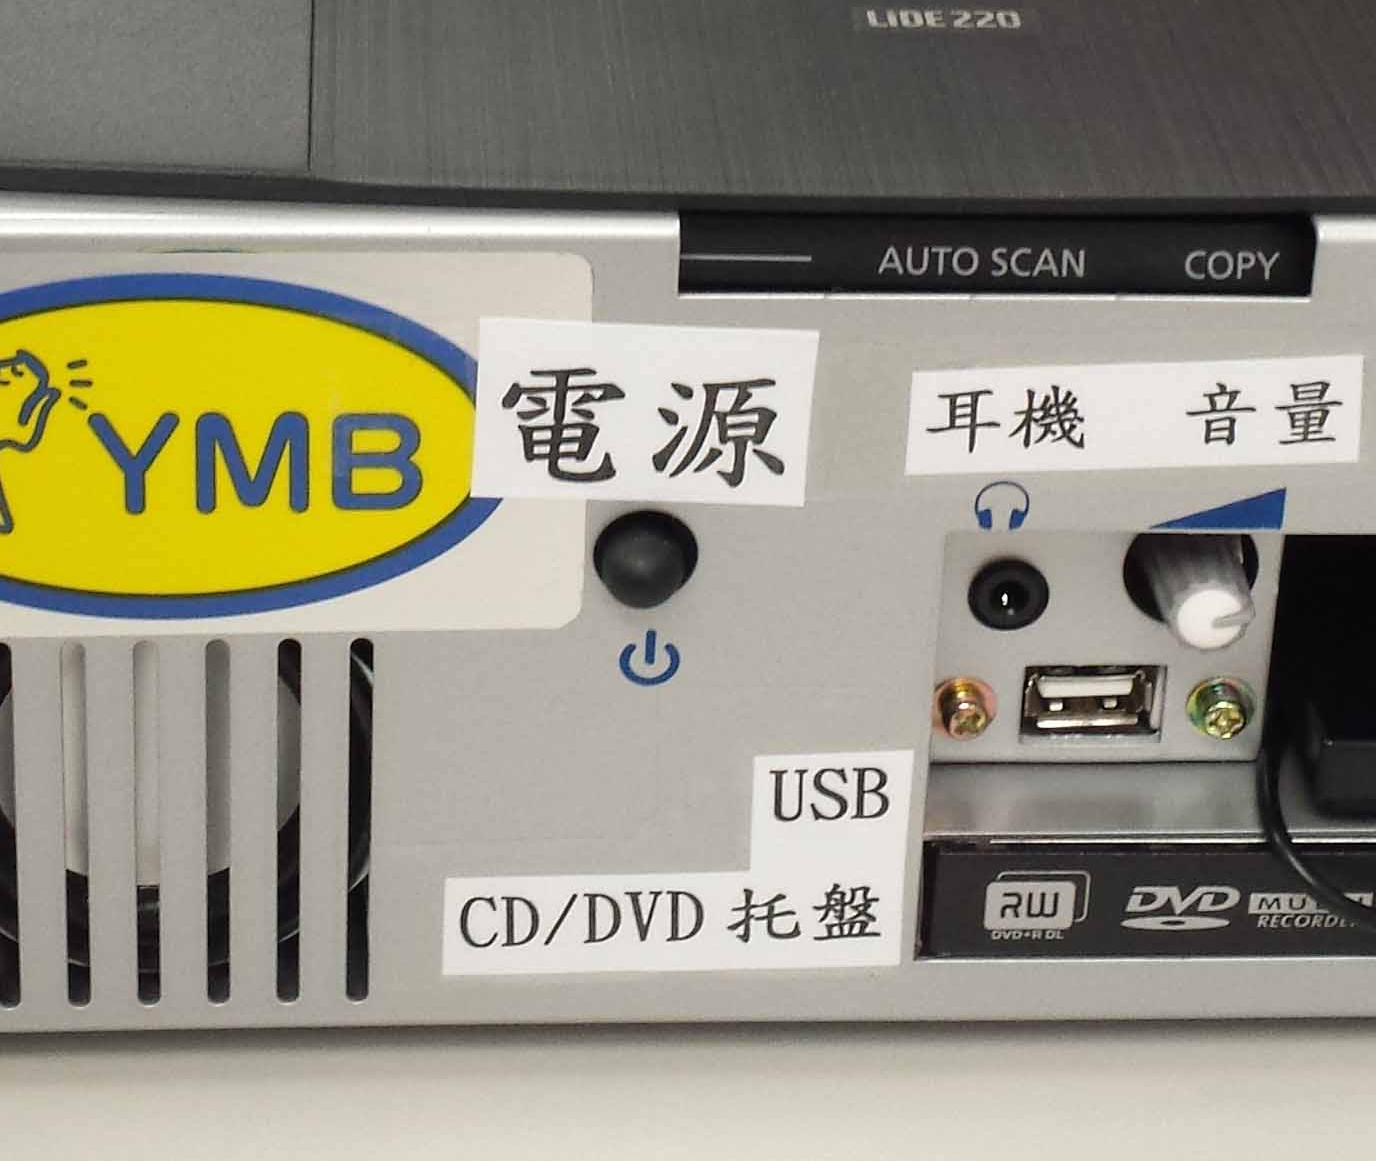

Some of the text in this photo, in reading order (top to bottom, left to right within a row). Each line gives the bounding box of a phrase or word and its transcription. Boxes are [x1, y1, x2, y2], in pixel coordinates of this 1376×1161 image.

[951, 9, 1021, 29] 220
[878, 246, 1280, 280] AUTO SCAN COPY
[503, 366, 786, 487] 電源
[926, 381, 1343, 453] 耳機 音量
[88, 411, 423, 515] YMB
[769, 767, 890, 822] USB
[459, 883, 881, 948] CD/DVD 托盤
[1001, 892, 1059, 918] RW
[1125, 885, 1241, 915] DVD
